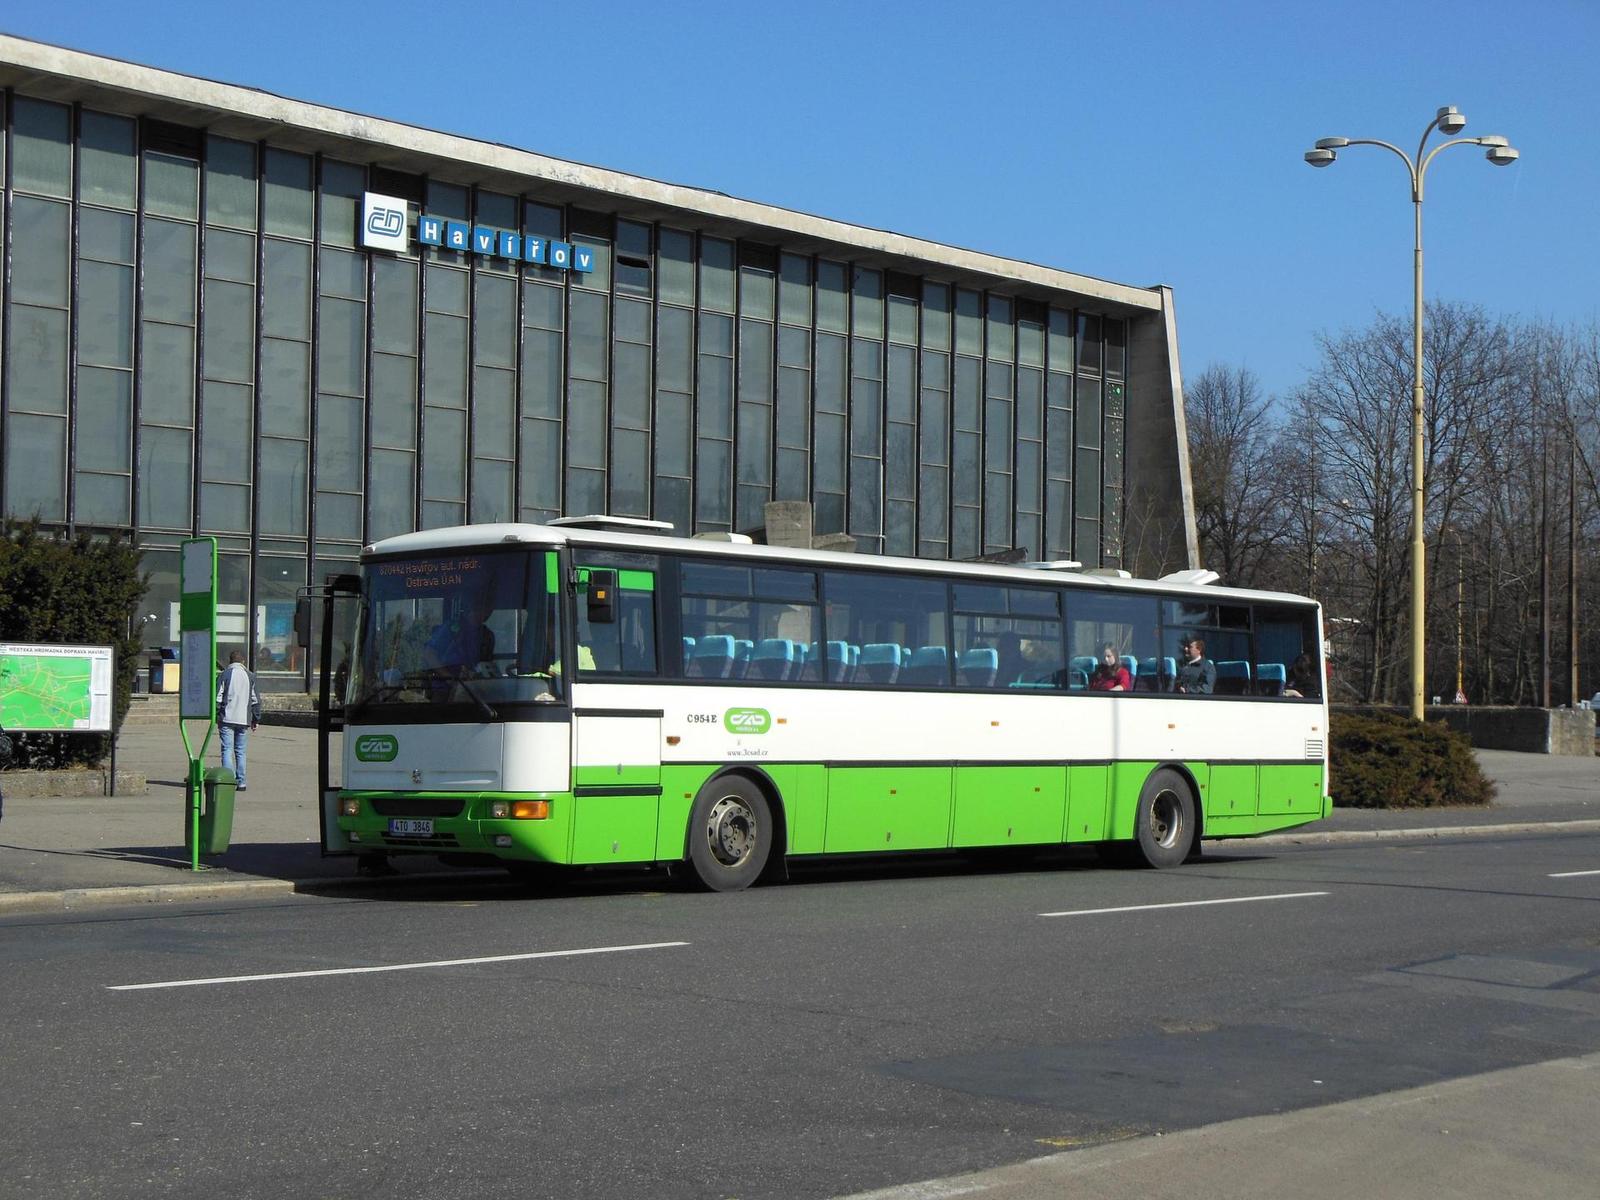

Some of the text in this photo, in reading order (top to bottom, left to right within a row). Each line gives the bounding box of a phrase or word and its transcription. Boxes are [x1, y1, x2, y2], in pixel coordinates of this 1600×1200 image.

[425, 221, 590, 267] Havířov
[406, 577, 439, 588] Ostrava
[687, 714, 718, 724] C954E
[727, 748, 769, 757] www.3csad.cz
[412, 821, 431, 833] 3846
